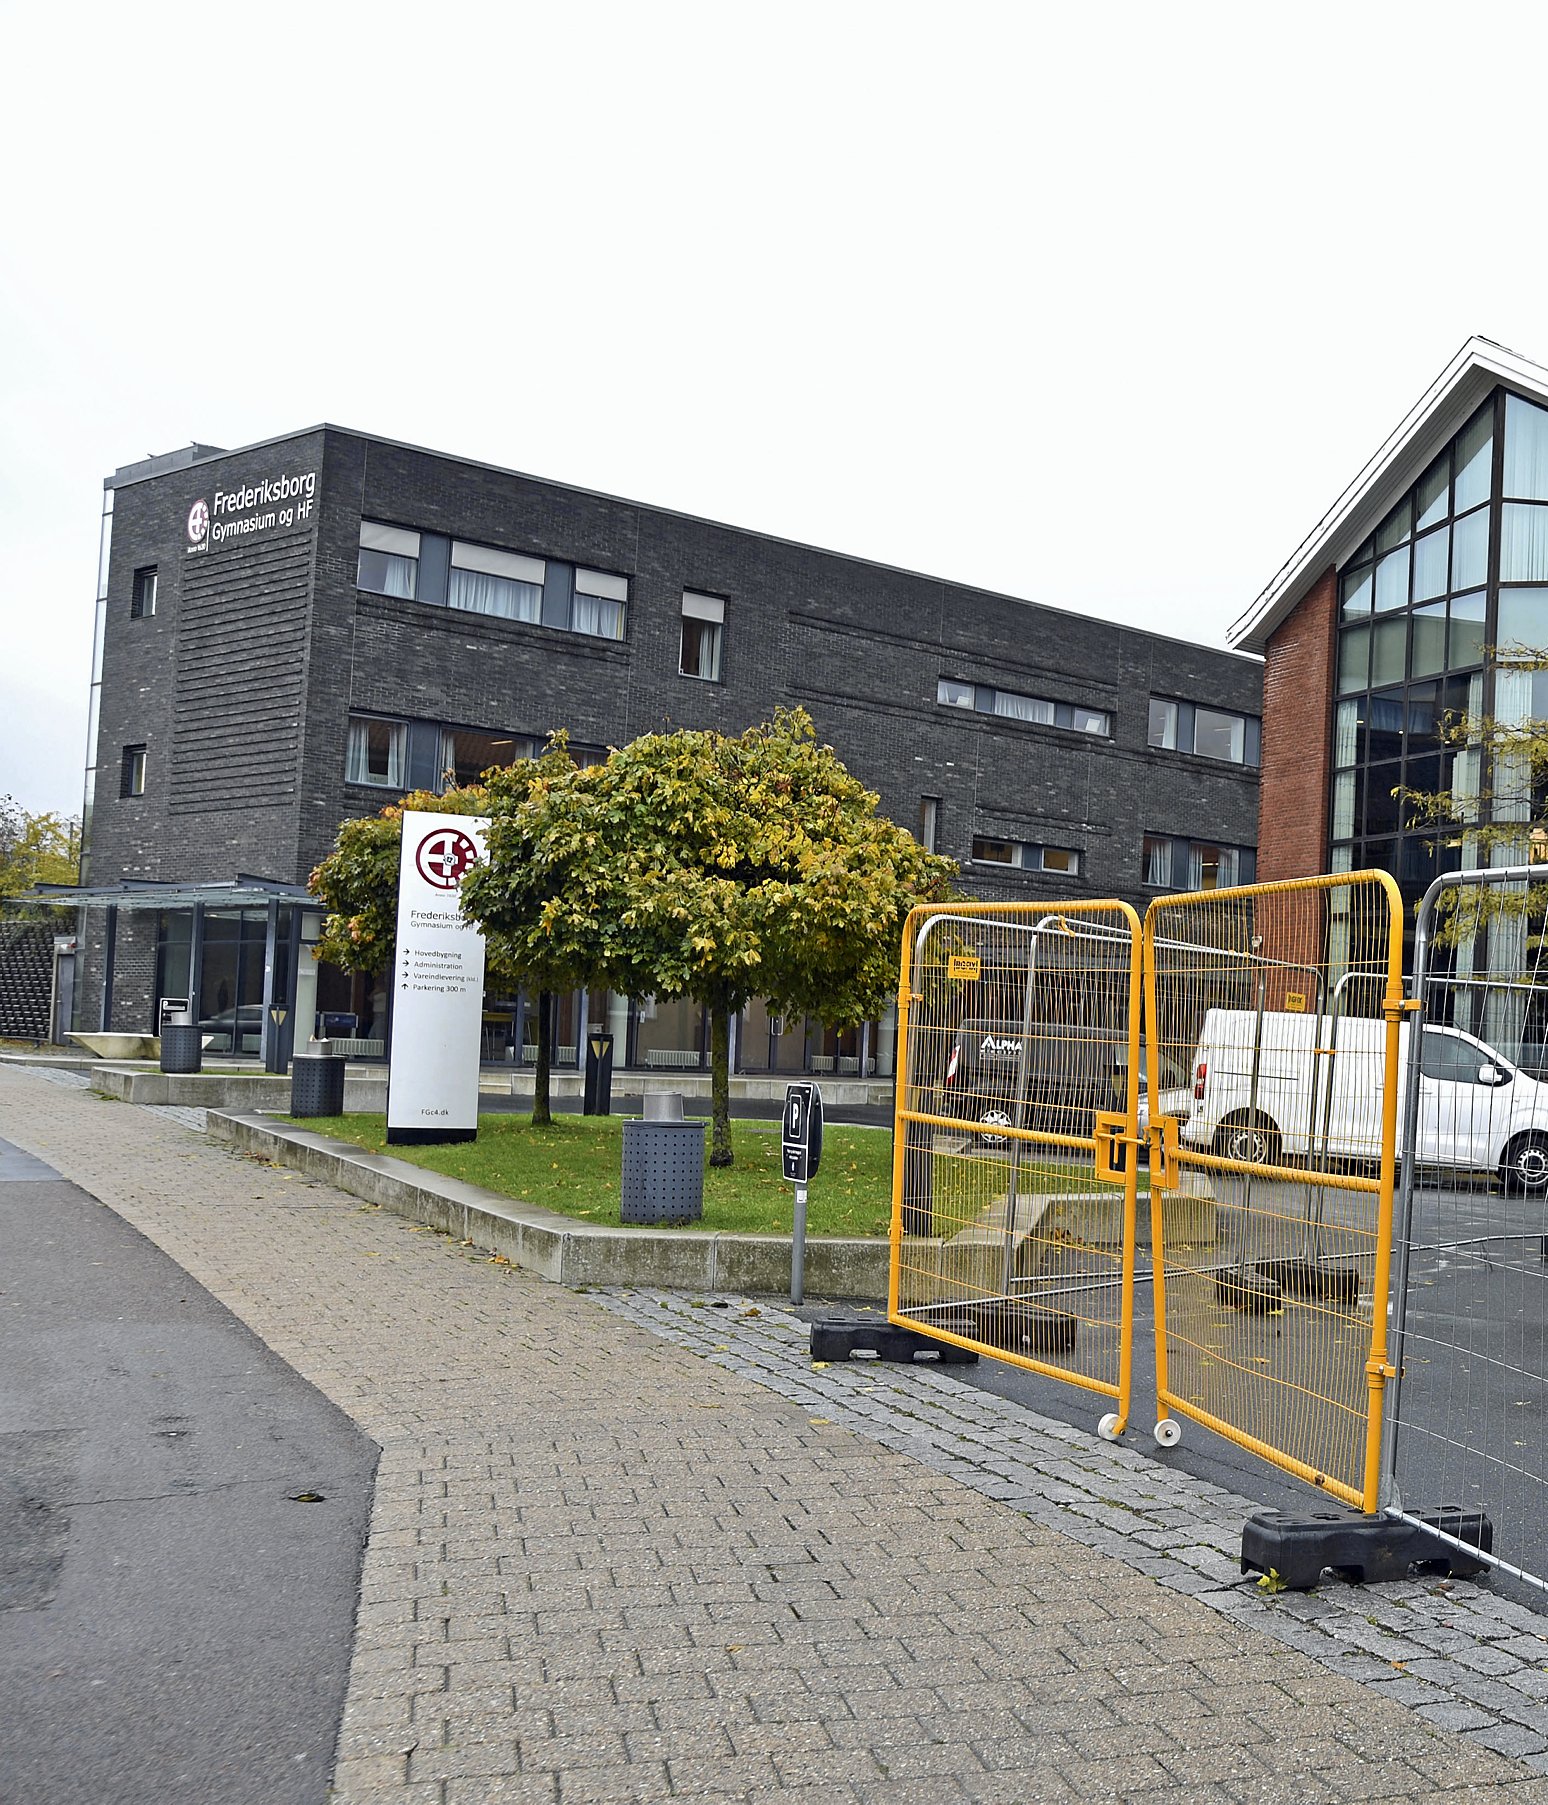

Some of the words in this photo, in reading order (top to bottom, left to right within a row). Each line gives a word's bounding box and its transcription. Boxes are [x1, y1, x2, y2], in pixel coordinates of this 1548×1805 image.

[213, 472, 316, 516] Frederiksborg
[212, 513, 276, 543] Gymnasium
[279, 508, 294, 527] og
[297, 500, 314, 520] HF
[410, 920, 453, 930] Gymnasium
[414, 950, 462, 960] Hovedbygning
[414, 961, 463, 970] Administration
[413, 972, 465, 982] Vareindlevering
[412, 983, 445, 993] Parkering
[446, 985, 459, 993] 300
[421, 1108, 450, 1116] FGc4.dk
